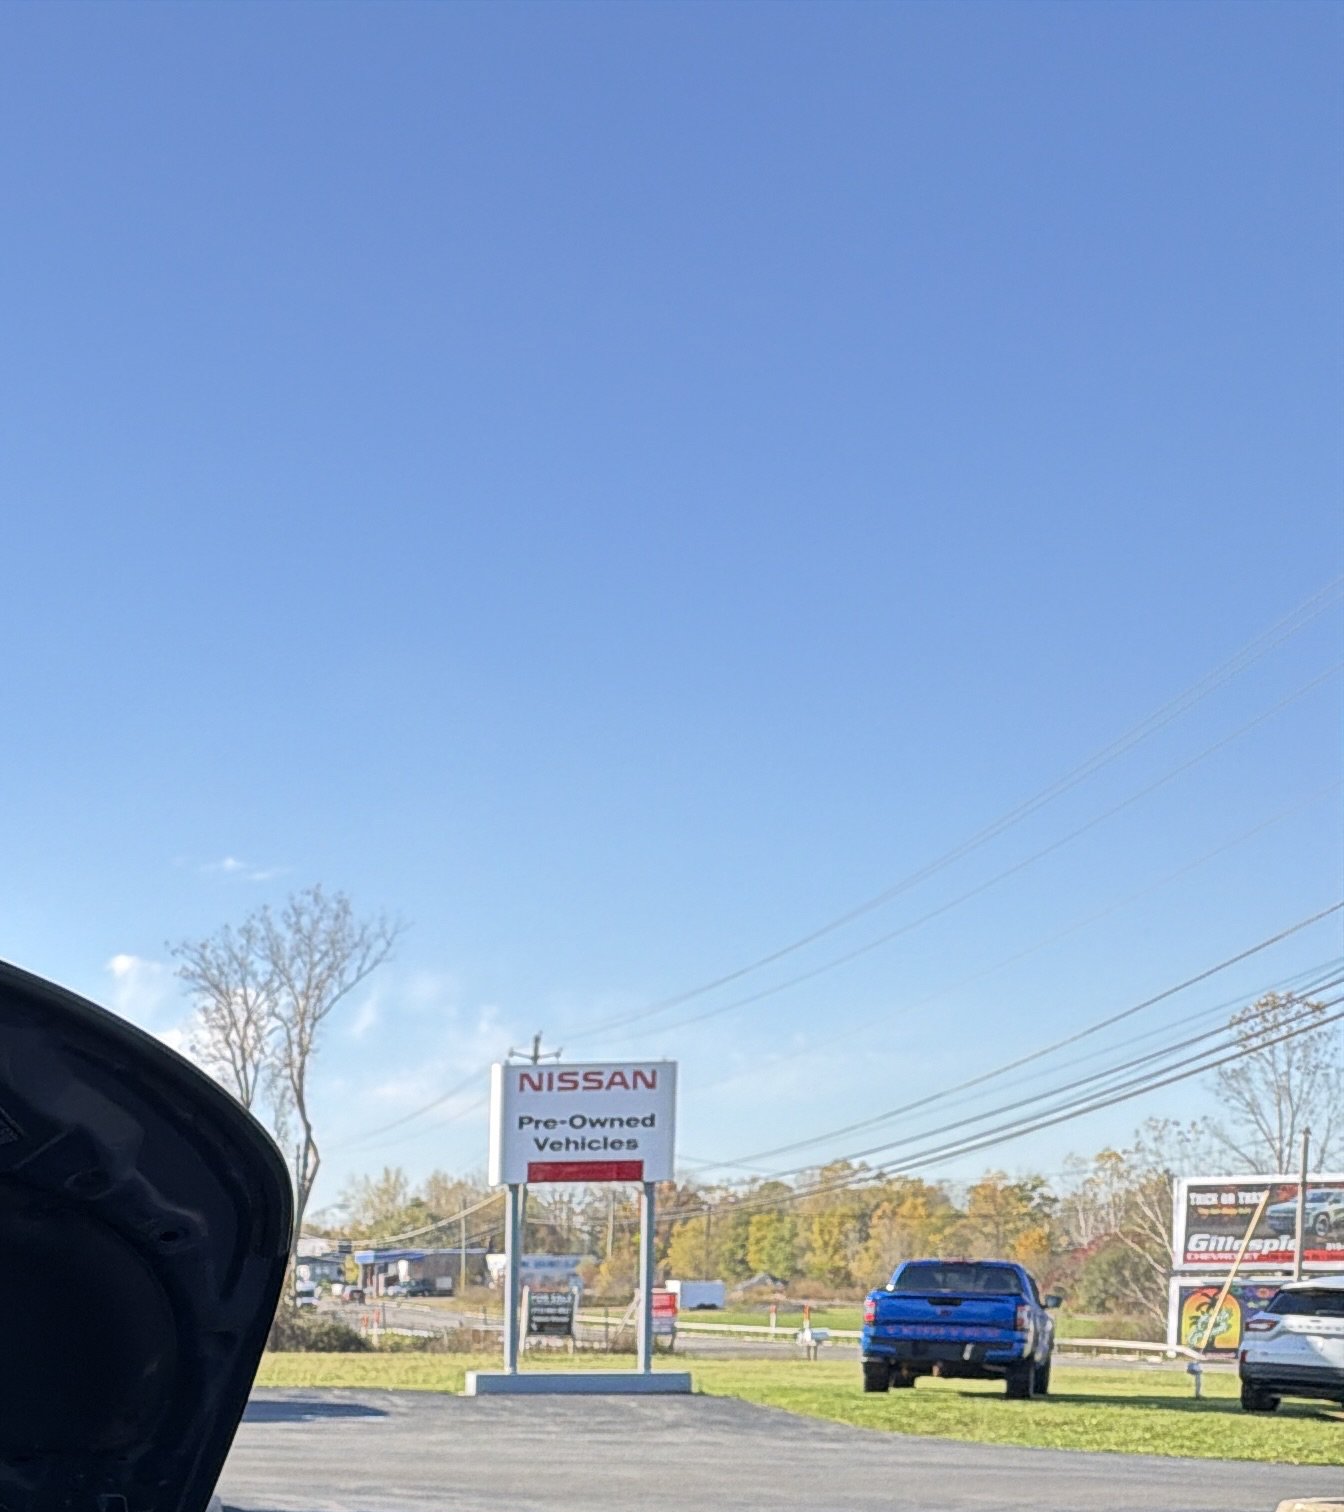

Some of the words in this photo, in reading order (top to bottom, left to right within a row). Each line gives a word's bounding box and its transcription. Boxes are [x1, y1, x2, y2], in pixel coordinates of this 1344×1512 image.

[518, 1069, 658, 1092] NISSAN
[518, 1113, 656, 1130] Pre-Owned
[533, 1136, 639, 1152] Vehicles
